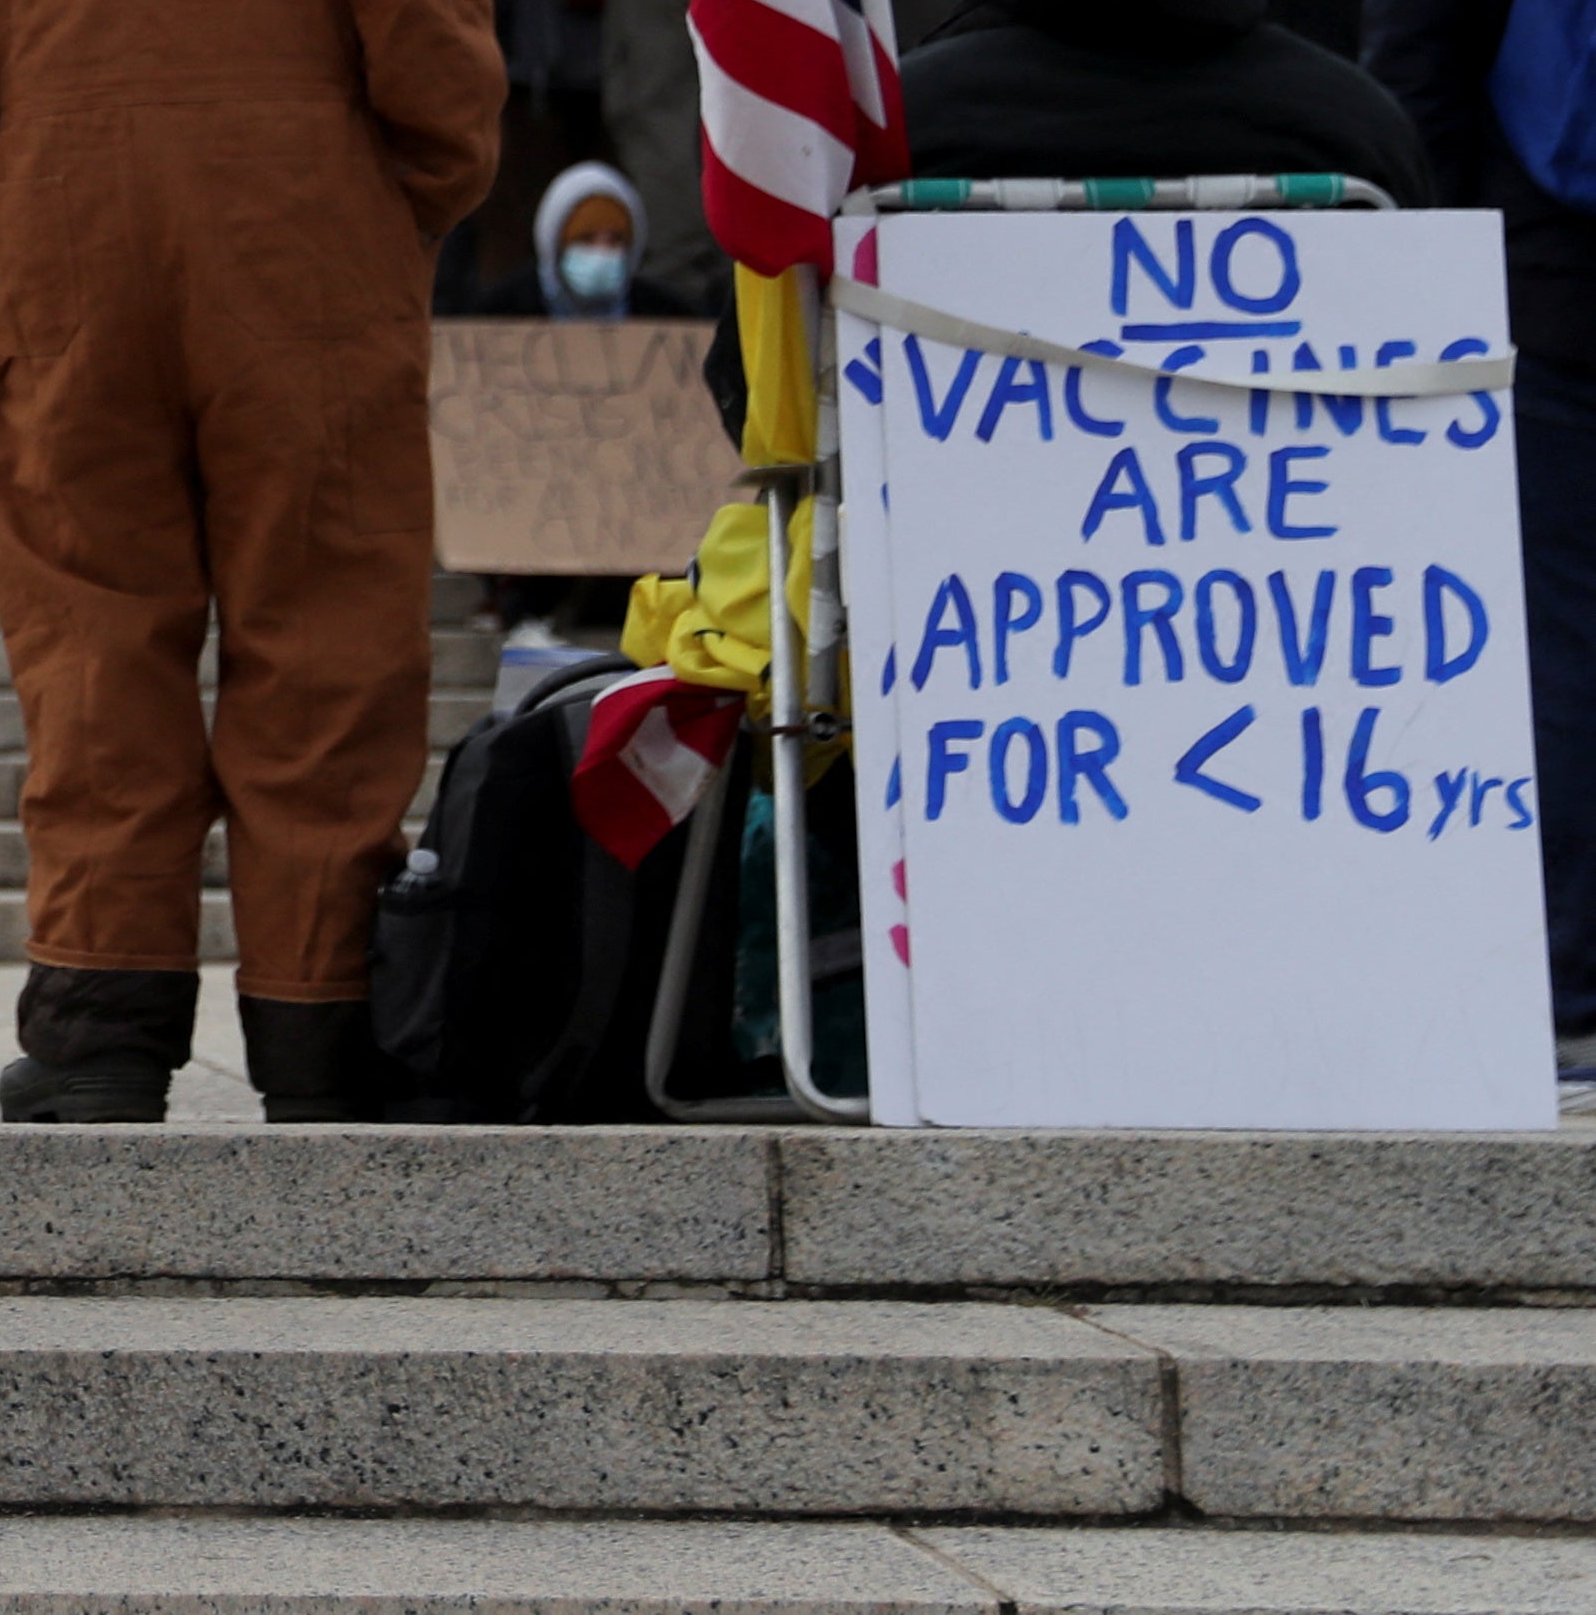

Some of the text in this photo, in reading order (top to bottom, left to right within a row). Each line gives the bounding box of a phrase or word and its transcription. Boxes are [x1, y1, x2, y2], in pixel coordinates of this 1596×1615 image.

[1109, 216, 1302, 318] NO
[903, 332, 1504, 451] VACCINES
[1080, 439, 1340, 547] ARE
[910, 563, 1491, 691] APPROVED
[924, 708, 1131, 827] FOR
[1427, 766, 1536, 840] yrs
